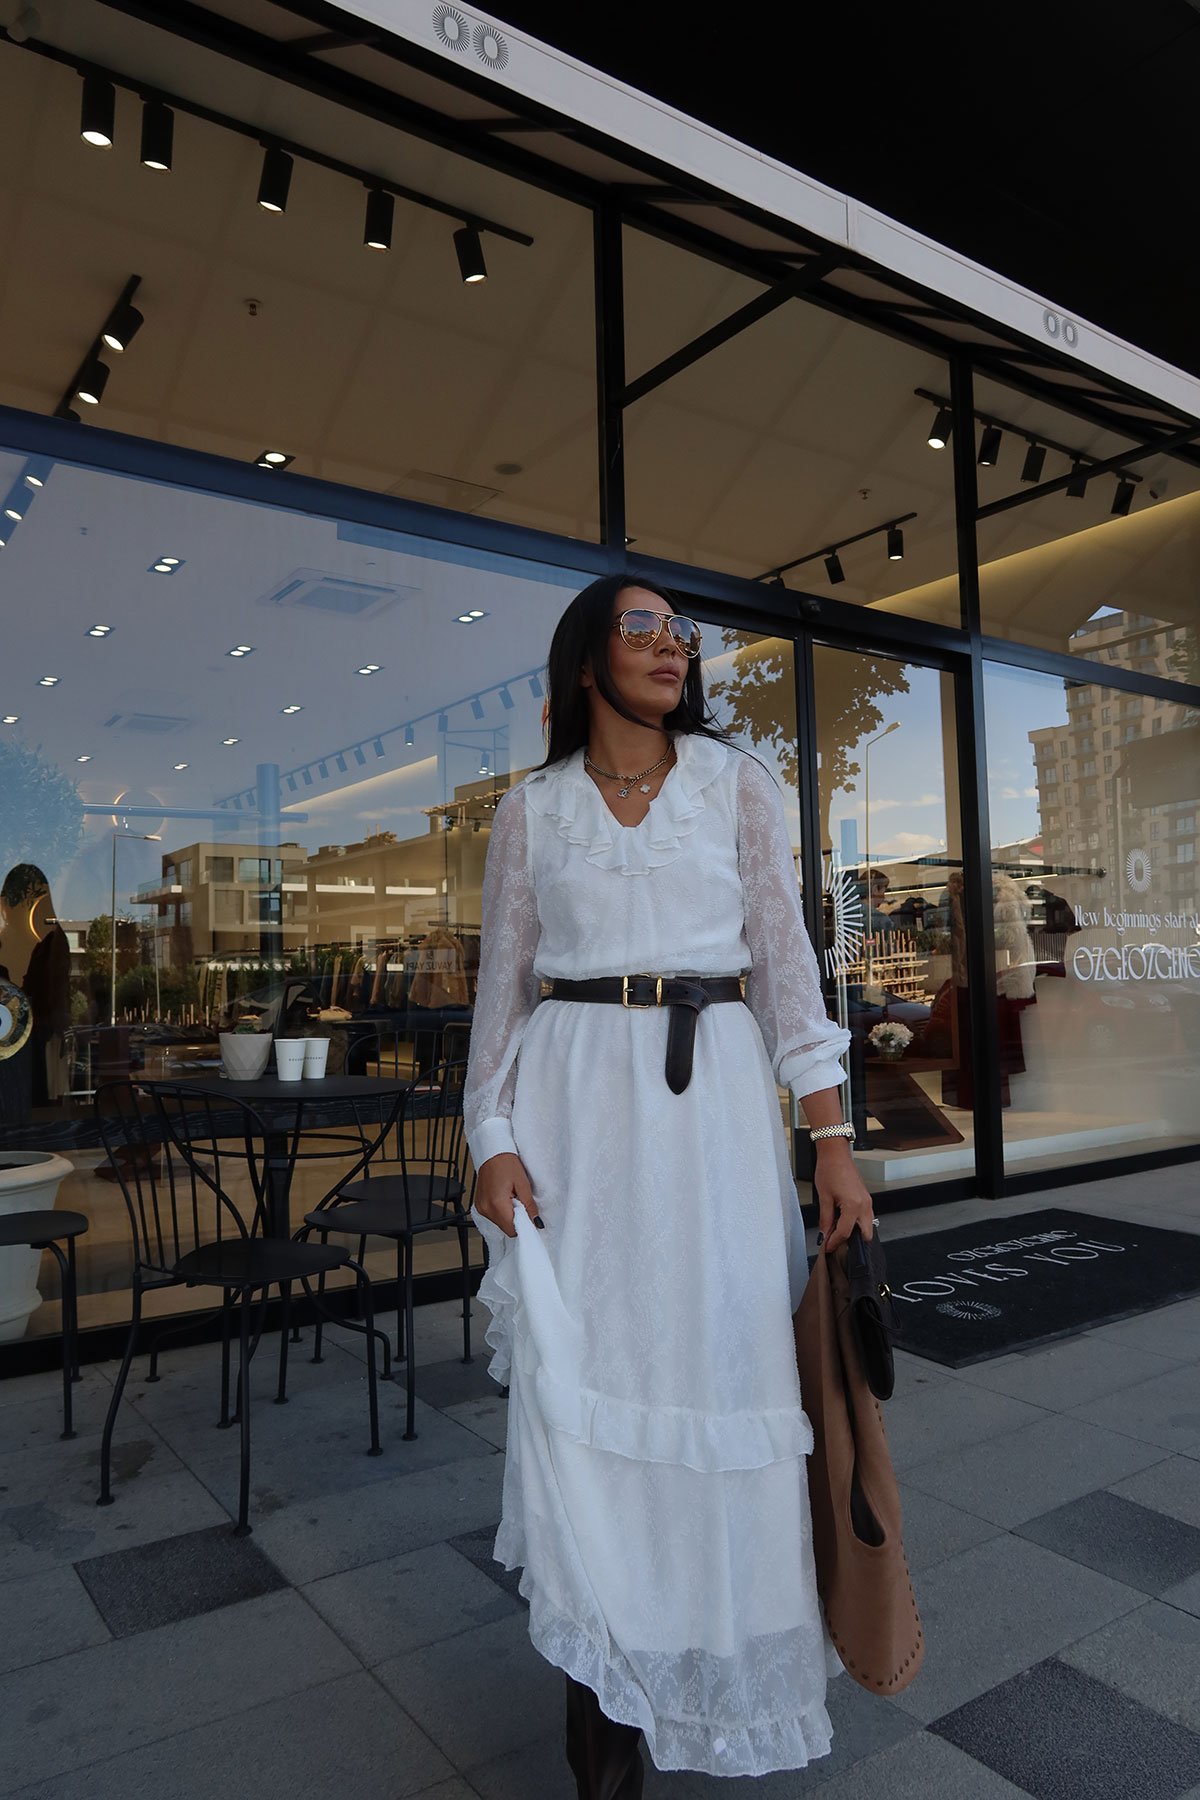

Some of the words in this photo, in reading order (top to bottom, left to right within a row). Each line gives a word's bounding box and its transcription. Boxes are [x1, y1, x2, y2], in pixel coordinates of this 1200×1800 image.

[1074, 905, 1100, 927] New
[1103, 907, 1161, 936] beginnings
[1164, 912, 1187, 928] start
